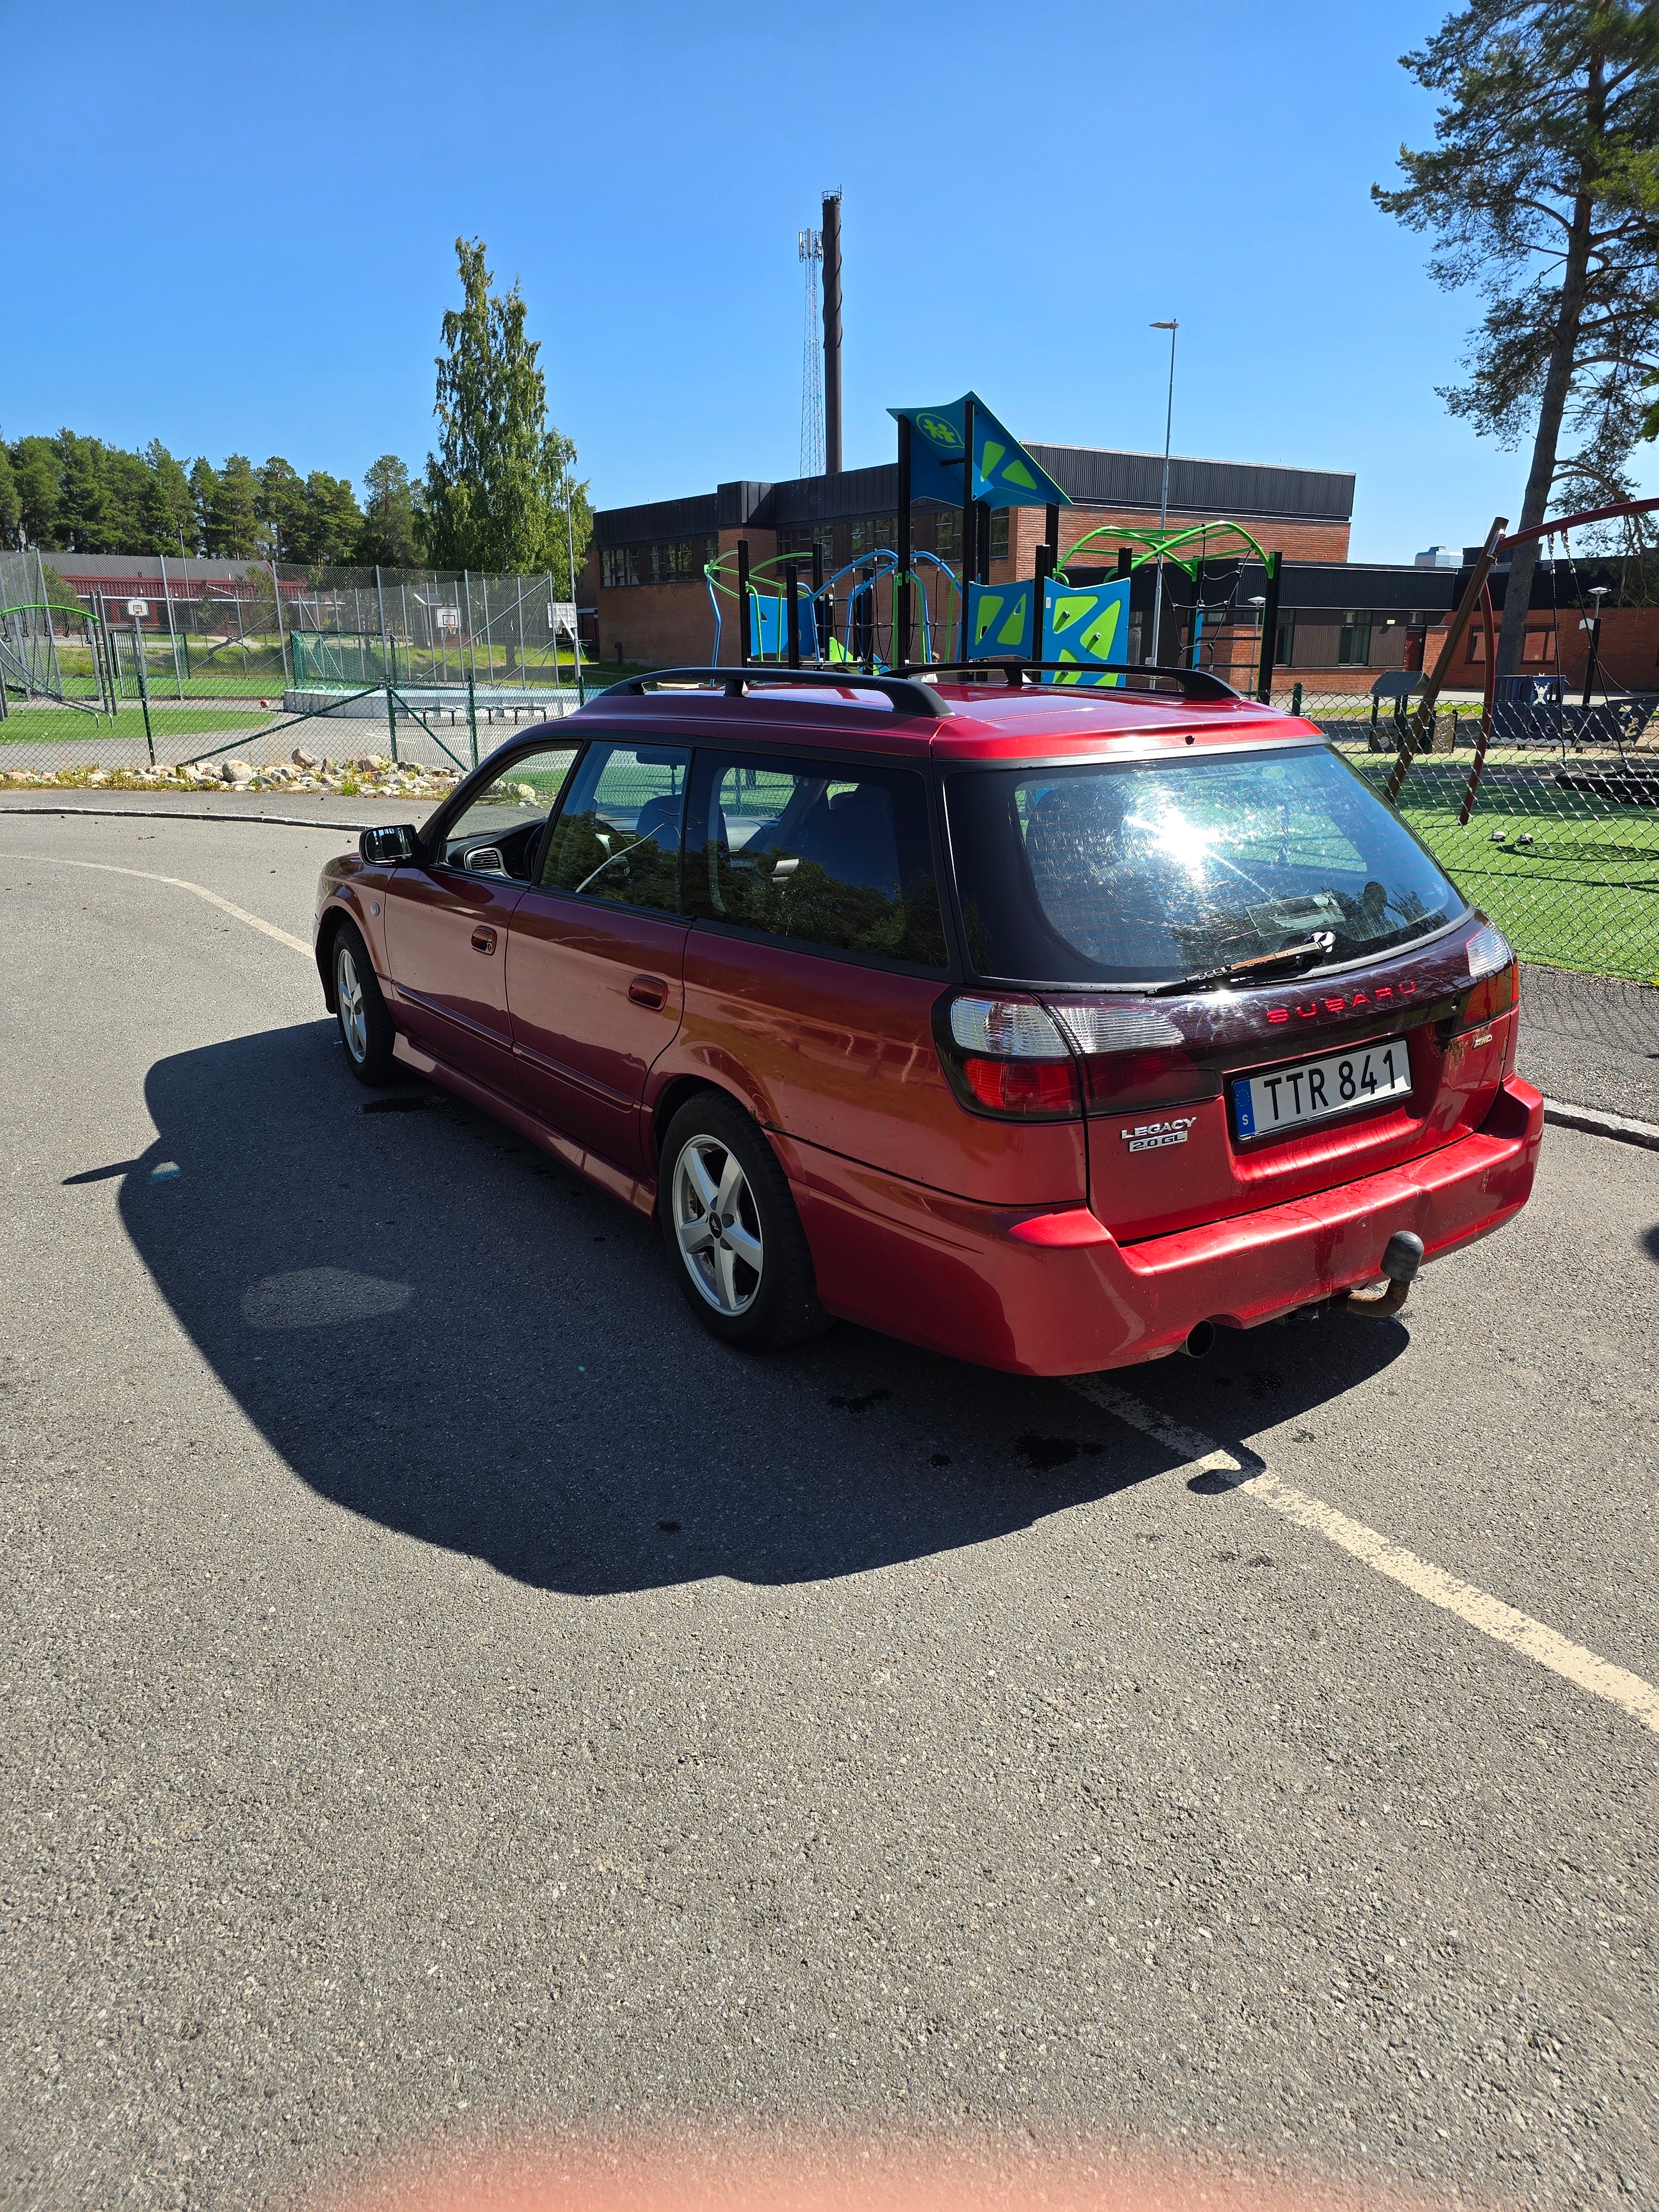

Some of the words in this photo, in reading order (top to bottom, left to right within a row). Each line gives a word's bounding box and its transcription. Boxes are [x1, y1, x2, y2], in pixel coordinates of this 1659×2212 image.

[1266, 980, 1417, 1023] SUBARU
[1263, 1068, 1329, 1120] TTR
[1338, 1050, 1395, 1102] 841
[1121, 1117, 1197, 1139] LEGACY
[1241, 1114, 1249, 1126] S
[1132, 1138, 1159, 1150] 2.0
[1161, 1134, 1186, 1144] GL
